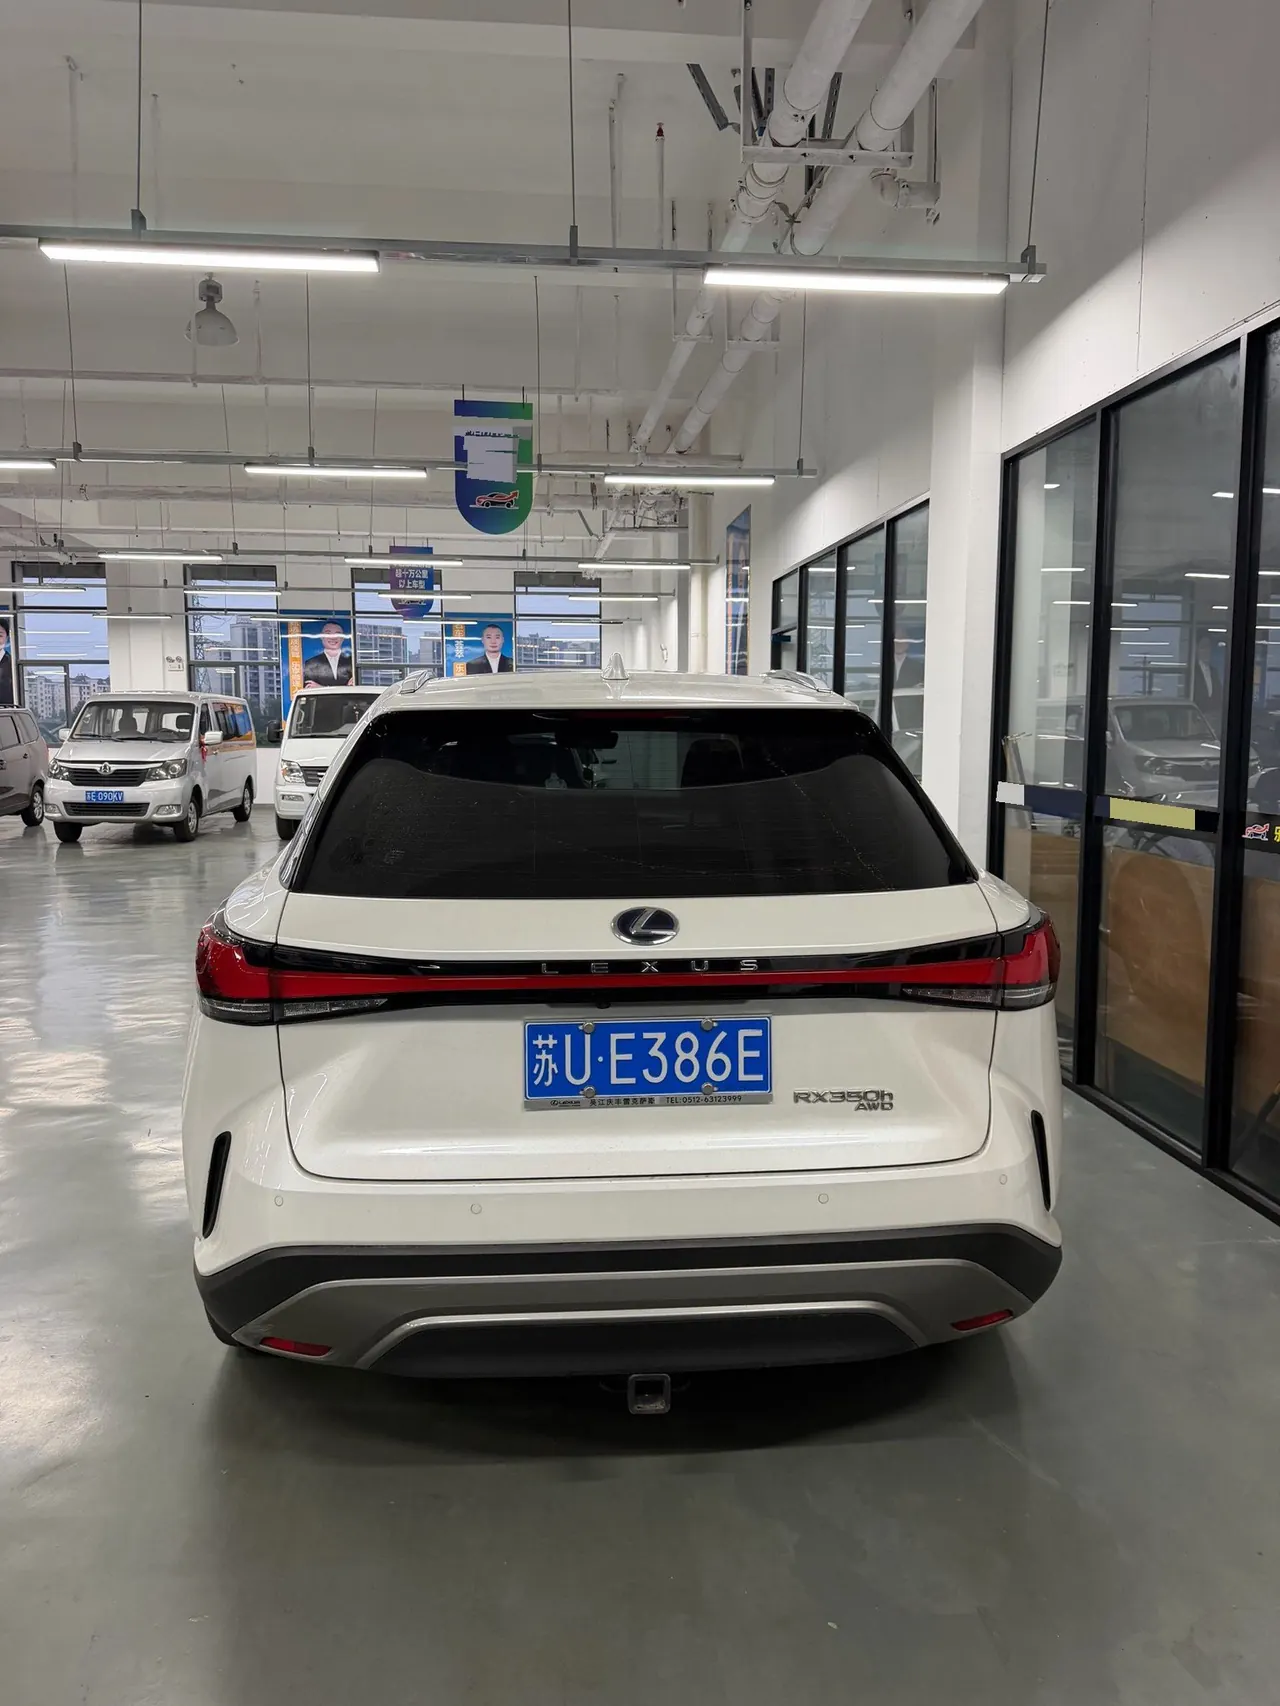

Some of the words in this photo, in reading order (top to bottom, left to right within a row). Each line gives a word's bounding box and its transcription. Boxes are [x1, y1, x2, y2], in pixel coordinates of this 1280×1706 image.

[541, 959, 758, 974] LEXUS
[665, 1095, 743, 1104] TEL:0512-63123999
[793, 1088, 894, 1104] RX350h
[854, 1102, 894, 1112] AWD
